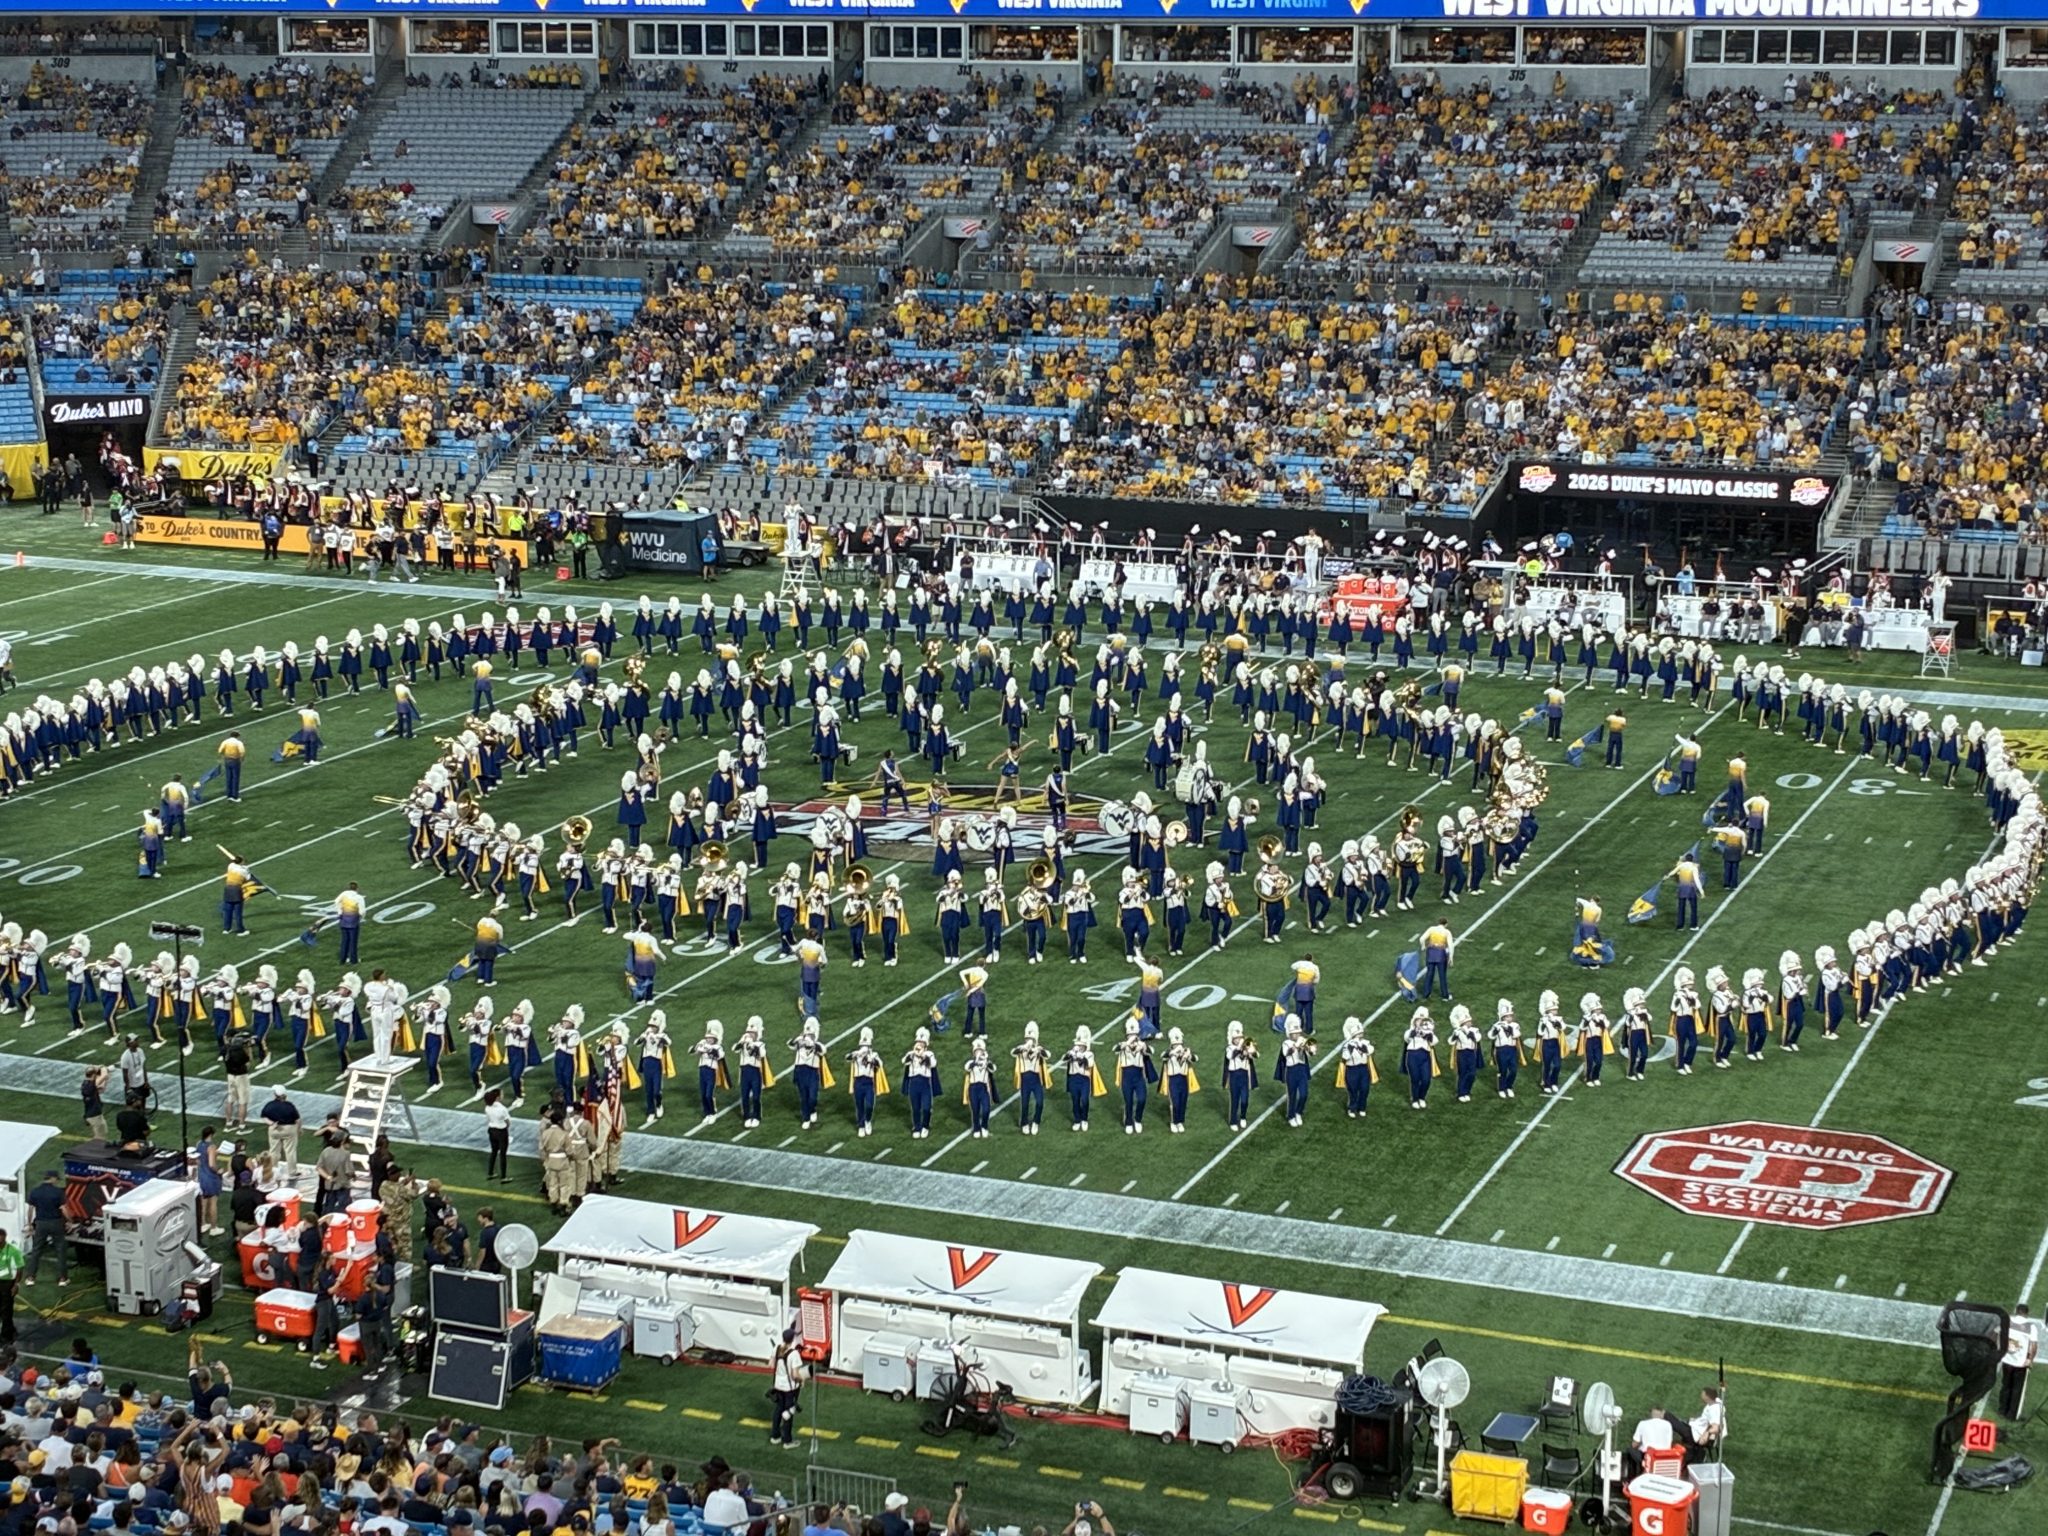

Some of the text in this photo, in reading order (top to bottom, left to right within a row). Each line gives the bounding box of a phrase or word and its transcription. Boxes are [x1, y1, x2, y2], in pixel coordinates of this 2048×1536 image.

[51, 57, 70, 68] 309
[486, 58, 500, 69] 311
[722, 61, 738, 73] 312
[957, 65, 973, 76] 313
[1508, 70, 1526, 81] 315
[50, 398, 143, 423] Duke's MAYO
[1568, 473, 1609, 491] 2026
[1611, 475, 1665, 494] DUKE'S
[1667, 478, 1714, 496] MAYO
[1715, 480, 1779, 499] CLASSIC
[161, 520, 205, 538] Duke's
[630, 531, 665, 548] WVU
[632, 547, 688, 564] Medicine
[1708, 1131, 1895, 1166] WARNING
[1681, 1181, 1857, 1212] SECURITY
[1679, 1193, 1843, 1222] SYSTEMS
[274, 1316, 287, 1331] G
[1968, 1423, 1991, 1447] 20
[1532, 1508, 1547, 1526] G
[1639, 1507, 1664, 1536] G
